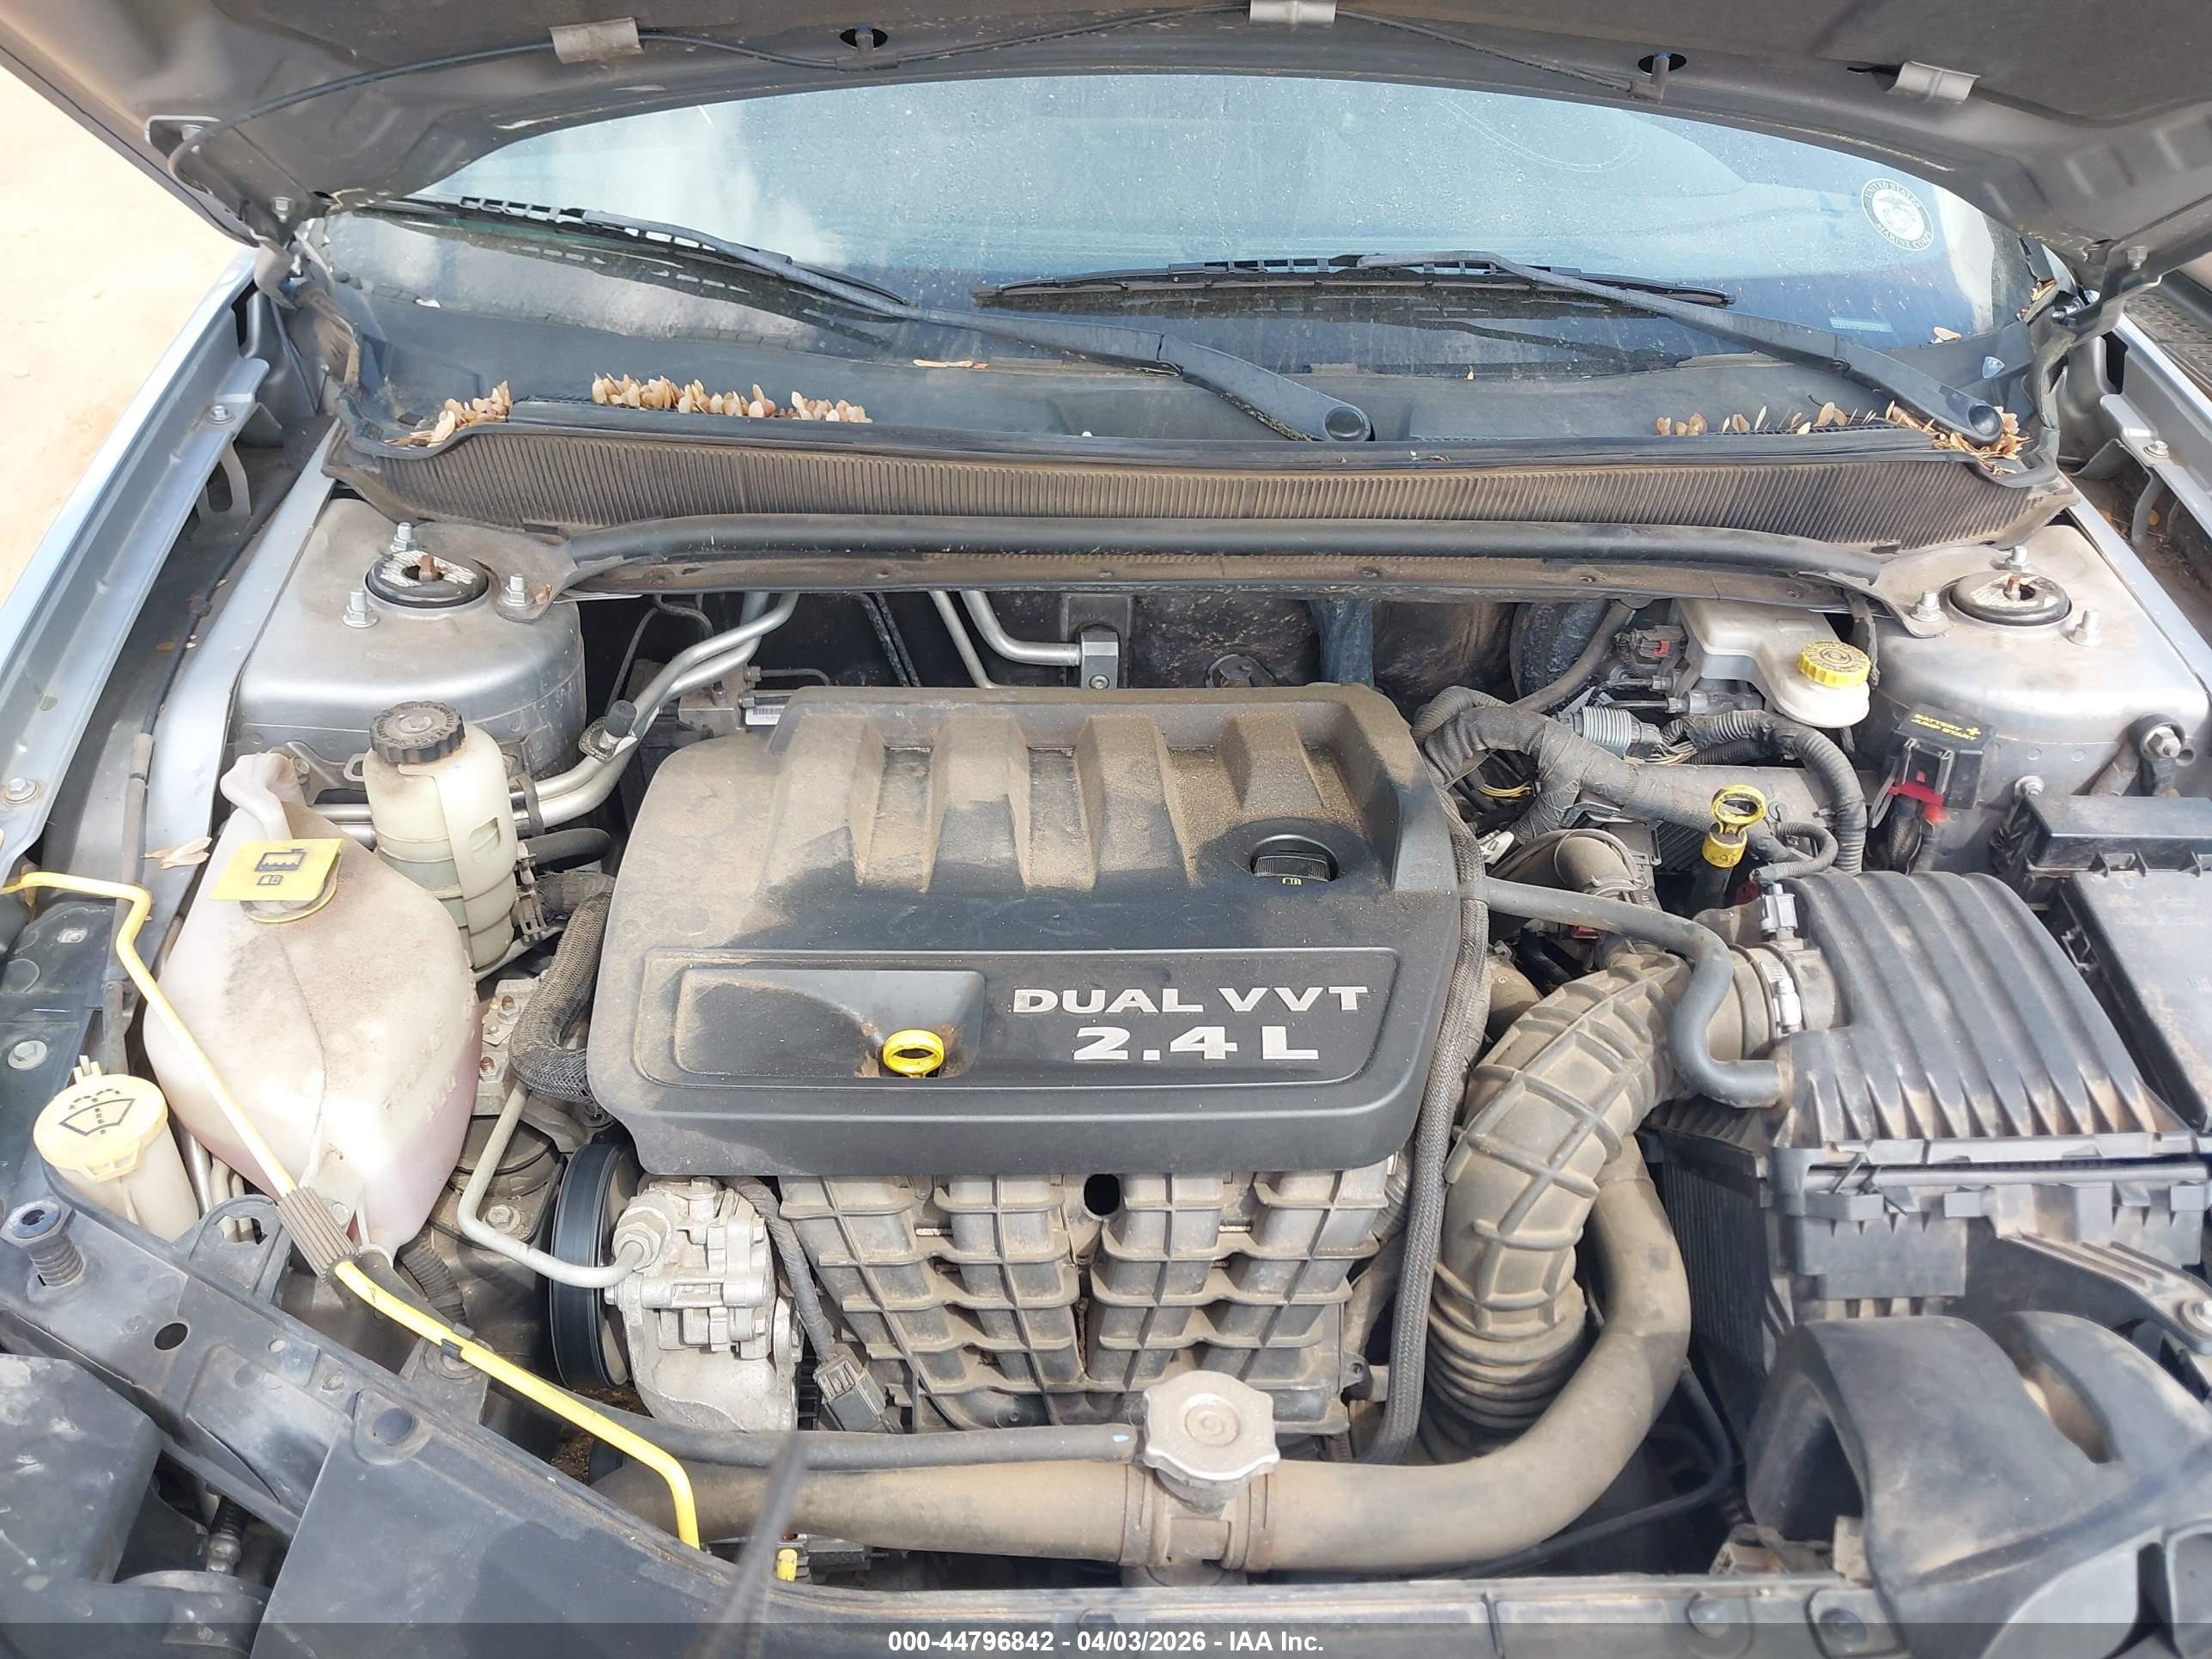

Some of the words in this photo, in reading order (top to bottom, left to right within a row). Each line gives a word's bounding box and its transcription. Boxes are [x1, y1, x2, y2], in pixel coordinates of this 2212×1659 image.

[1911, 719, 1941, 730] JUMP
[1941, 727, 1978, 741] START
[1914, 714, 1963, 731] BATTERY
[1012, 988, 1203, 1013] DUAL
[1218, 986, 1368, 1012] VVT
